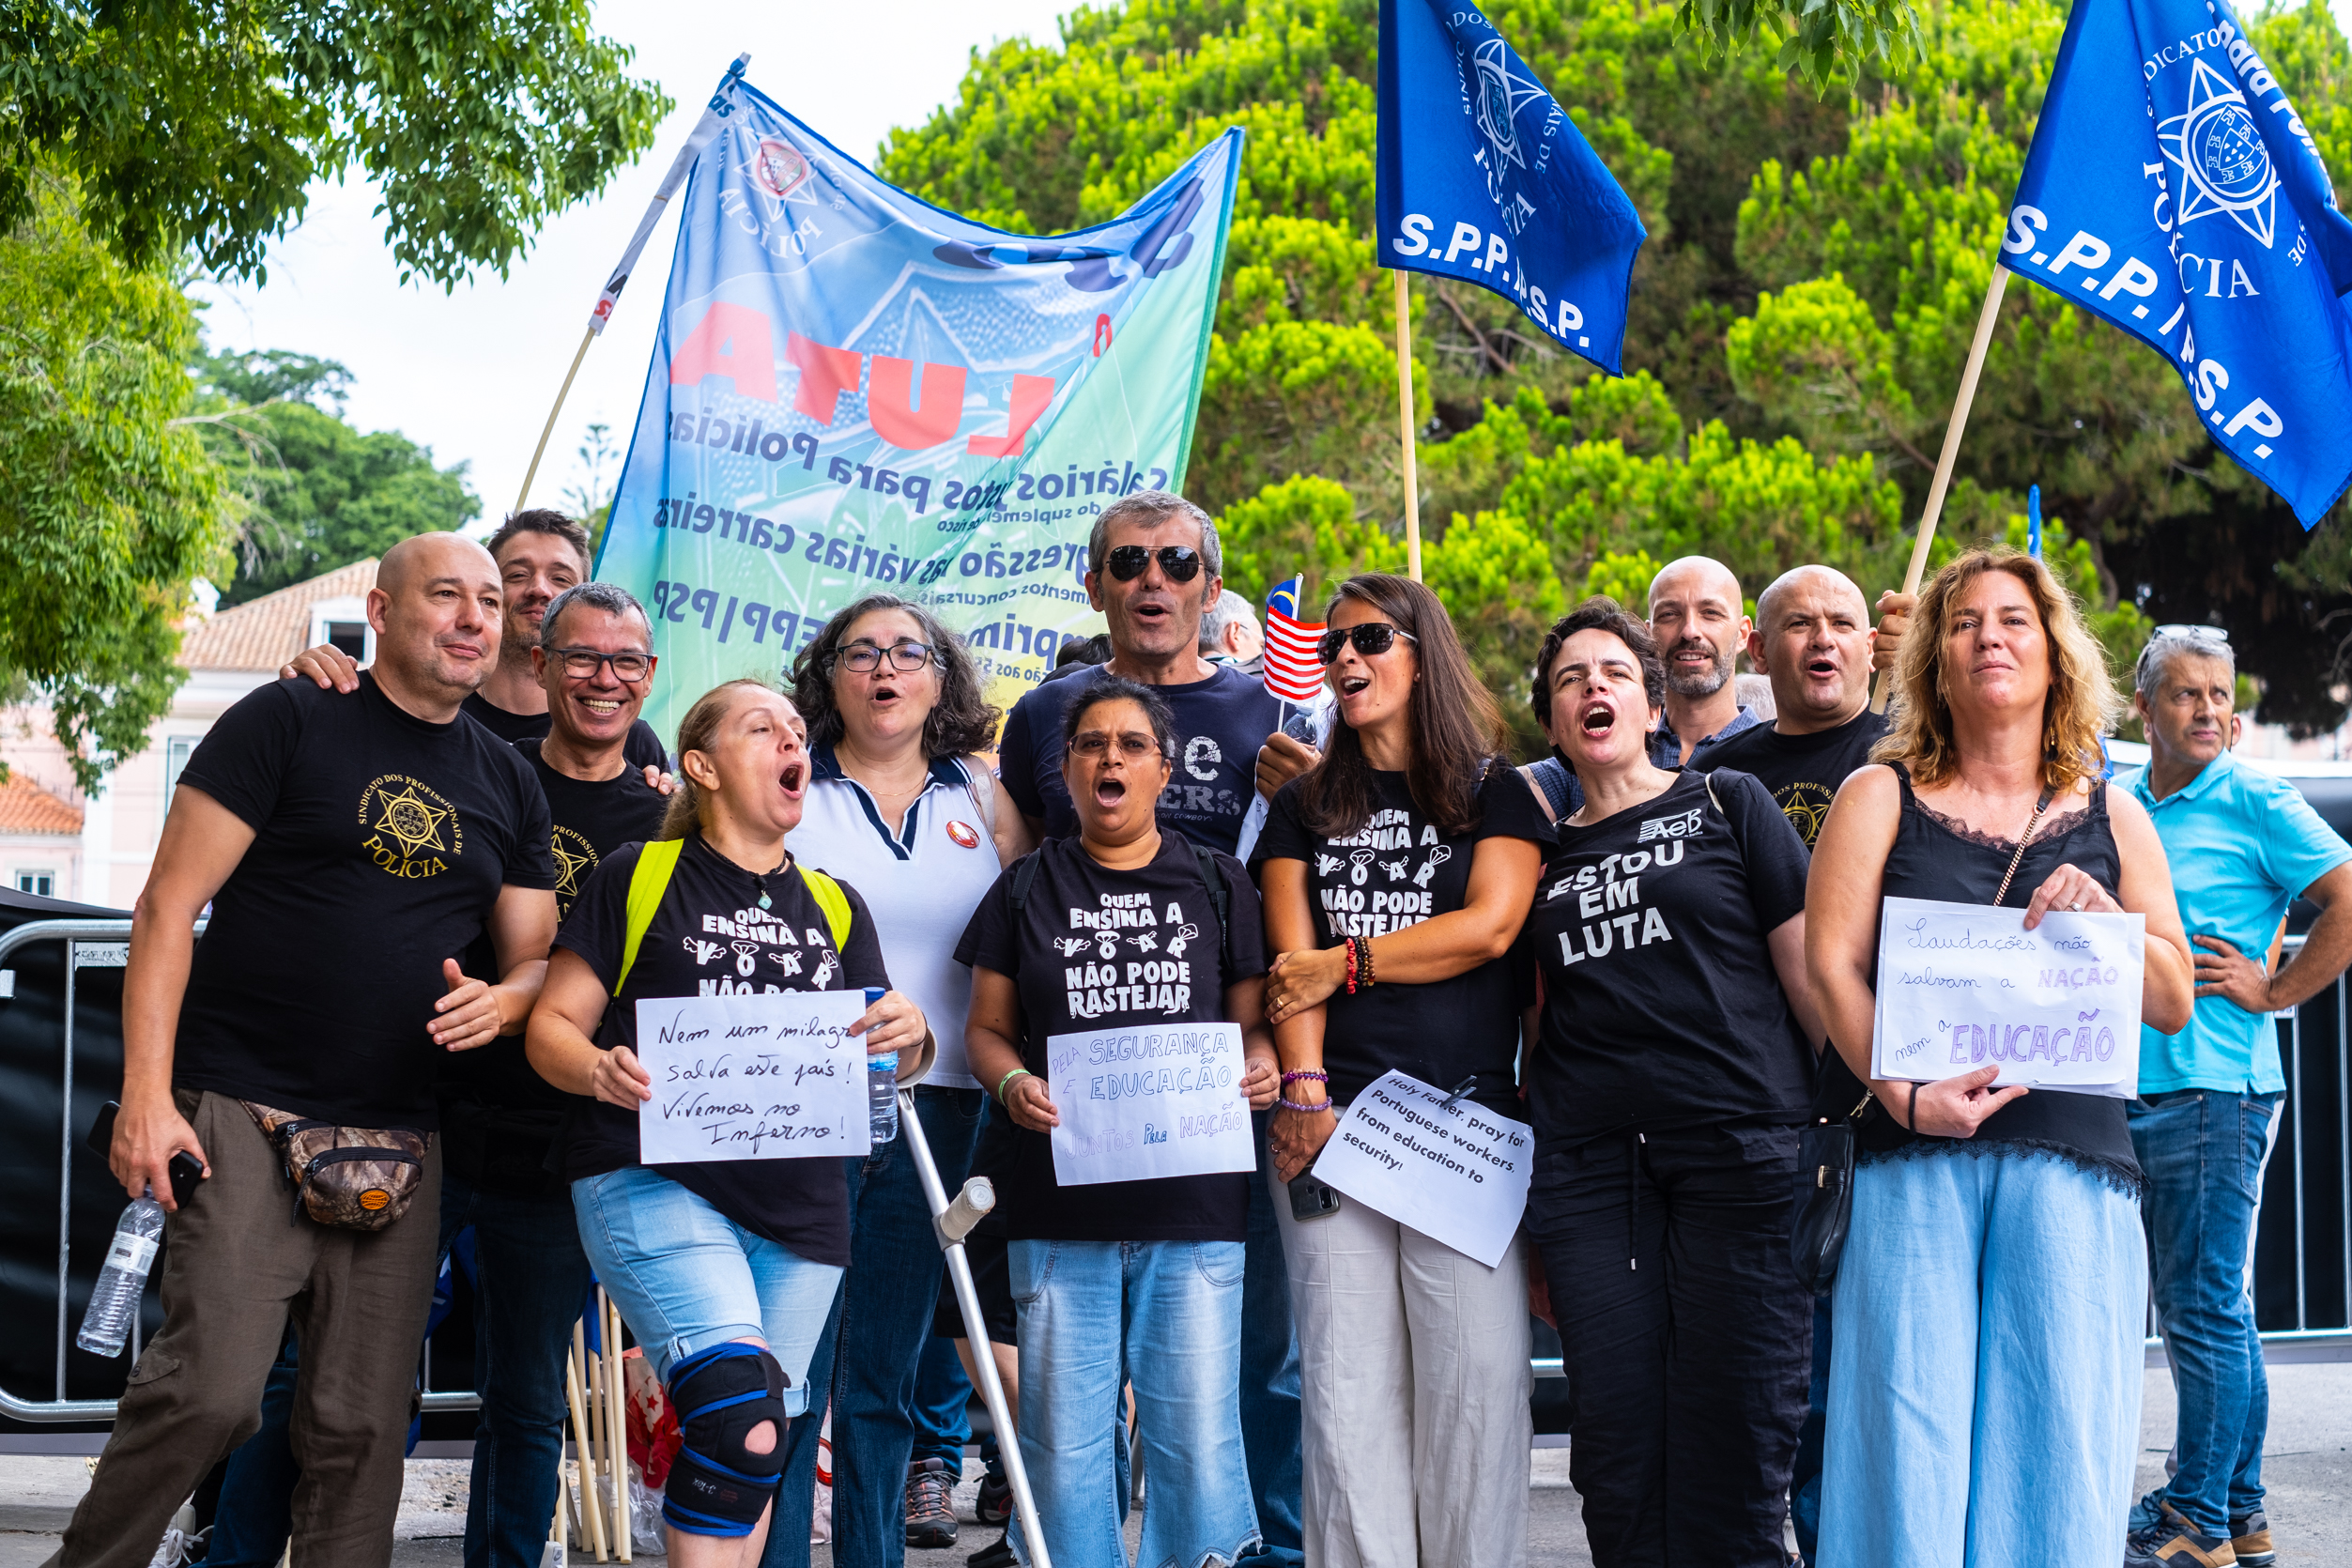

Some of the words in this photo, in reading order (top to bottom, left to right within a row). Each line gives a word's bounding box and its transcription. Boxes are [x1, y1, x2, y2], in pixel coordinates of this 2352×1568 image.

[358, 777, 384, 825] SINDICATO
[383, 774, 404, 783] DOS
[405, 776, 463, 839] PROFISSIONAIS
[453, 840, 463, 855] DE
[552, 824, 600, 868] PROFISSION
[1420, 824, 1438, 846] A
[1546, 839, 1684, 900] ESTOU
[1069, 907, 1157, 930] ENSINA
[1165, 902, 1183, 924] A
[1099, 893, 1151, 908] QUEM
[1320, 884, 1365, 913] NÃO
[1372, 891, 1433, 915] PODE
[1578, 876, 1639, 919] EM
[702, 914, 799, 946] ENSINA
[805, 928, 827, 946] A
[1558, 907, 1672, 966] LUTA
[1904, 917, 2037, 951] Laudações
[2054, 935, 2093, 951] não
[699, 974, 754, 996] NÃO
[1065, 961, 1117, 990] NÃO
[1127, 961, 1191, 984] PODE
[1897, 966, 1982, 989] salvam
[2000, 977, 2016, 988] a
[2037, 956, 2119, 990] NAÇÃO
[1067, 984, 1191, 1020] RASTEJAR
[659, 1008, 711, 1044] Nem
[725, 1025, 768, 1039] um
[1896, 1036, 1931, 1061] nem
[1938, 1019, 1951, 1032] a
[1949, 1008, 2115, 1067] EDUCAÇÃO
[744, 1053, 787, 1077] este
[1052, 1046, 1082, 1076] PELA
[1088, 1033, 1229, 1066] SEGURANÇA
[1063, 1078, 1076, 1094] E
[1090, 1056, 1232, 1100] EDUCAÇÃO
[663, 1091, 755, 1120] Vivemos
[764, 1102, 802, 1115] no
[1388, 1078, 1421, 1097] Holy
[1468, 1117, 1506, 1142] pray
[1508, 1131, 1525, 1147] for
[1064, 1129, 1134, 1161] JUNTOS
[1179, 1101, 1243, 1138] NAÇÃO
[1356, 1107, 1391, 1135] from
[1392, 1131, 1465, 1175] education
[1468, 1169, 1483, 1183] to
[1371, 1089, 1449, 1139] Portuguese
[1453, 1134, 1515, 1173] workers,
[1343, 1131, 1404, 1171] security!
